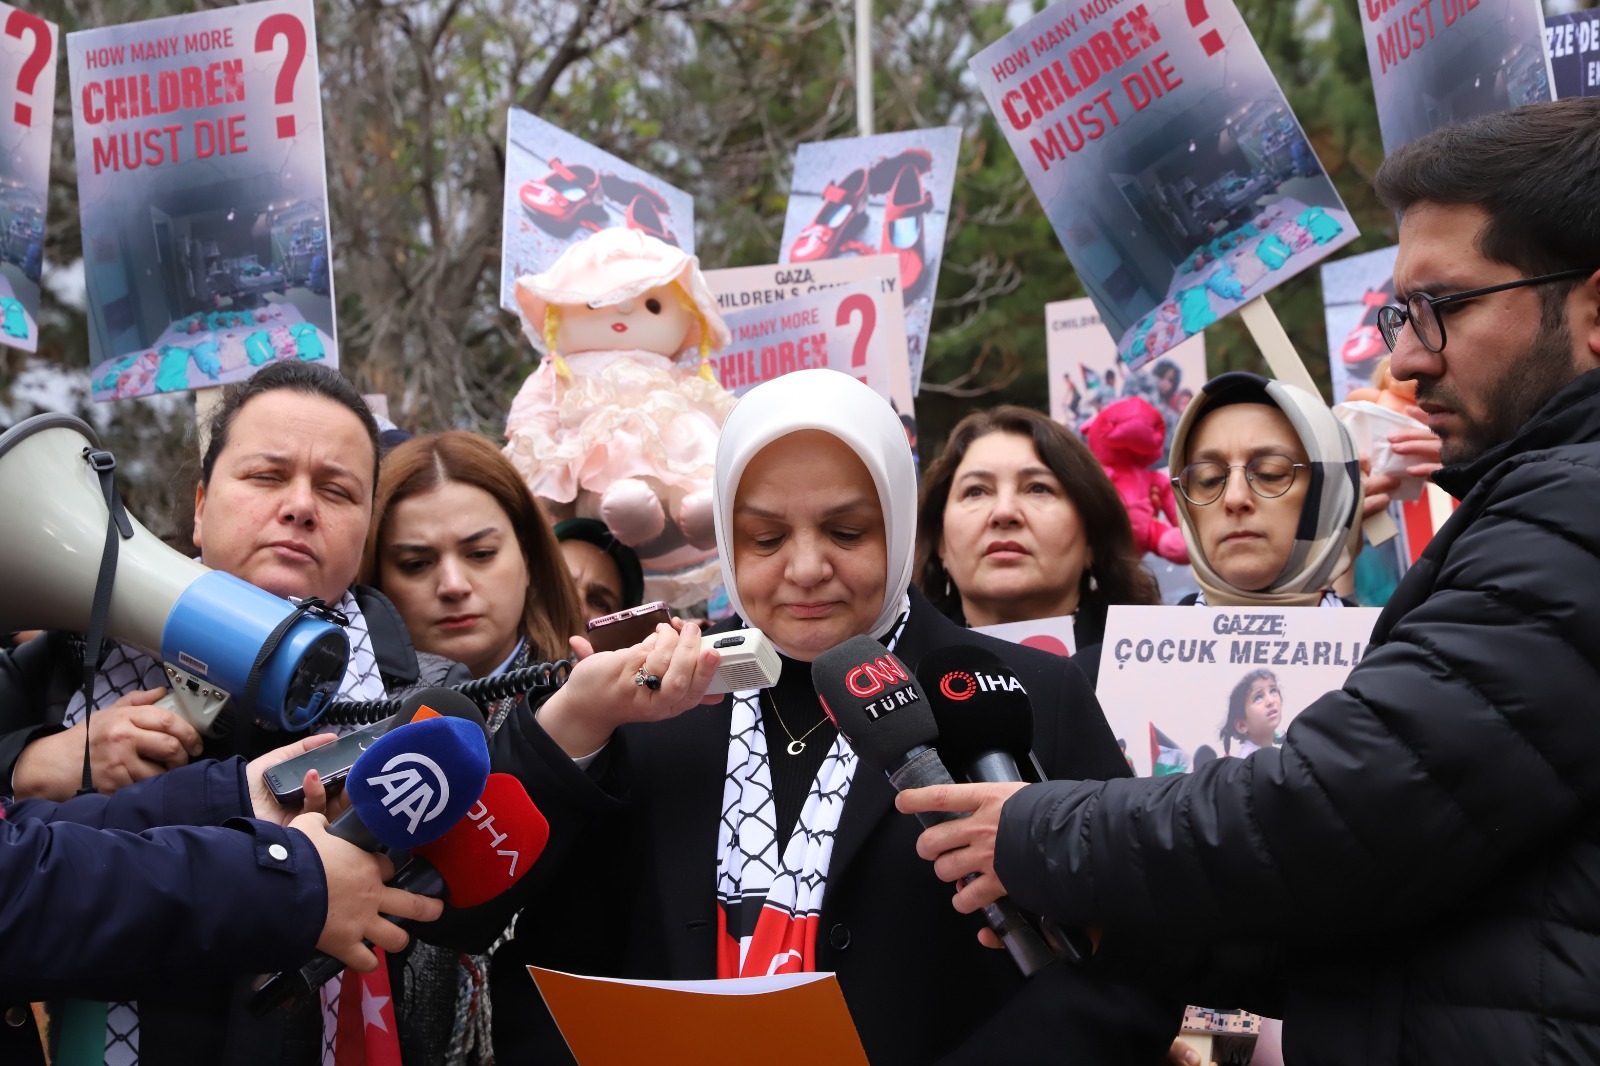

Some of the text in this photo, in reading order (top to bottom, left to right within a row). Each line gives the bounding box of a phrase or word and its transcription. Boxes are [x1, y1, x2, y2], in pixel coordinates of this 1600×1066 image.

[4, 8, 52, 127] ?
[86, 27, 234, 69] HOW MANY MORE
[991, 46, 1031, 83] HOW
[1030, 14, 1078, 57] MANY
[1002, 3, 1162, 131] CHILDREN
[1377, 0, 1435, 74] MUST
[1546, 19, 1600, 59] ZZE'DE
[82, 58, 246, 125] CHILDREN
[254, 13, 307, 139] ?
[93, 114, 248, 175] MUST DIE
[1029, 51, 1184, 172] MUST DIE
[738, 318, 777, 341] MANY
[781, 308, 819, 332] MORE
[835, 293, 877, 385] ?
[845, 654, 909, 698] CNN
[974, 671, 1027, 695] İHA
[1114, 638, 1361, 670] ÇOCUK MEZARLI
[865, 686, 919, 719] TÜRK
[366, 768, 434, 835] AA
